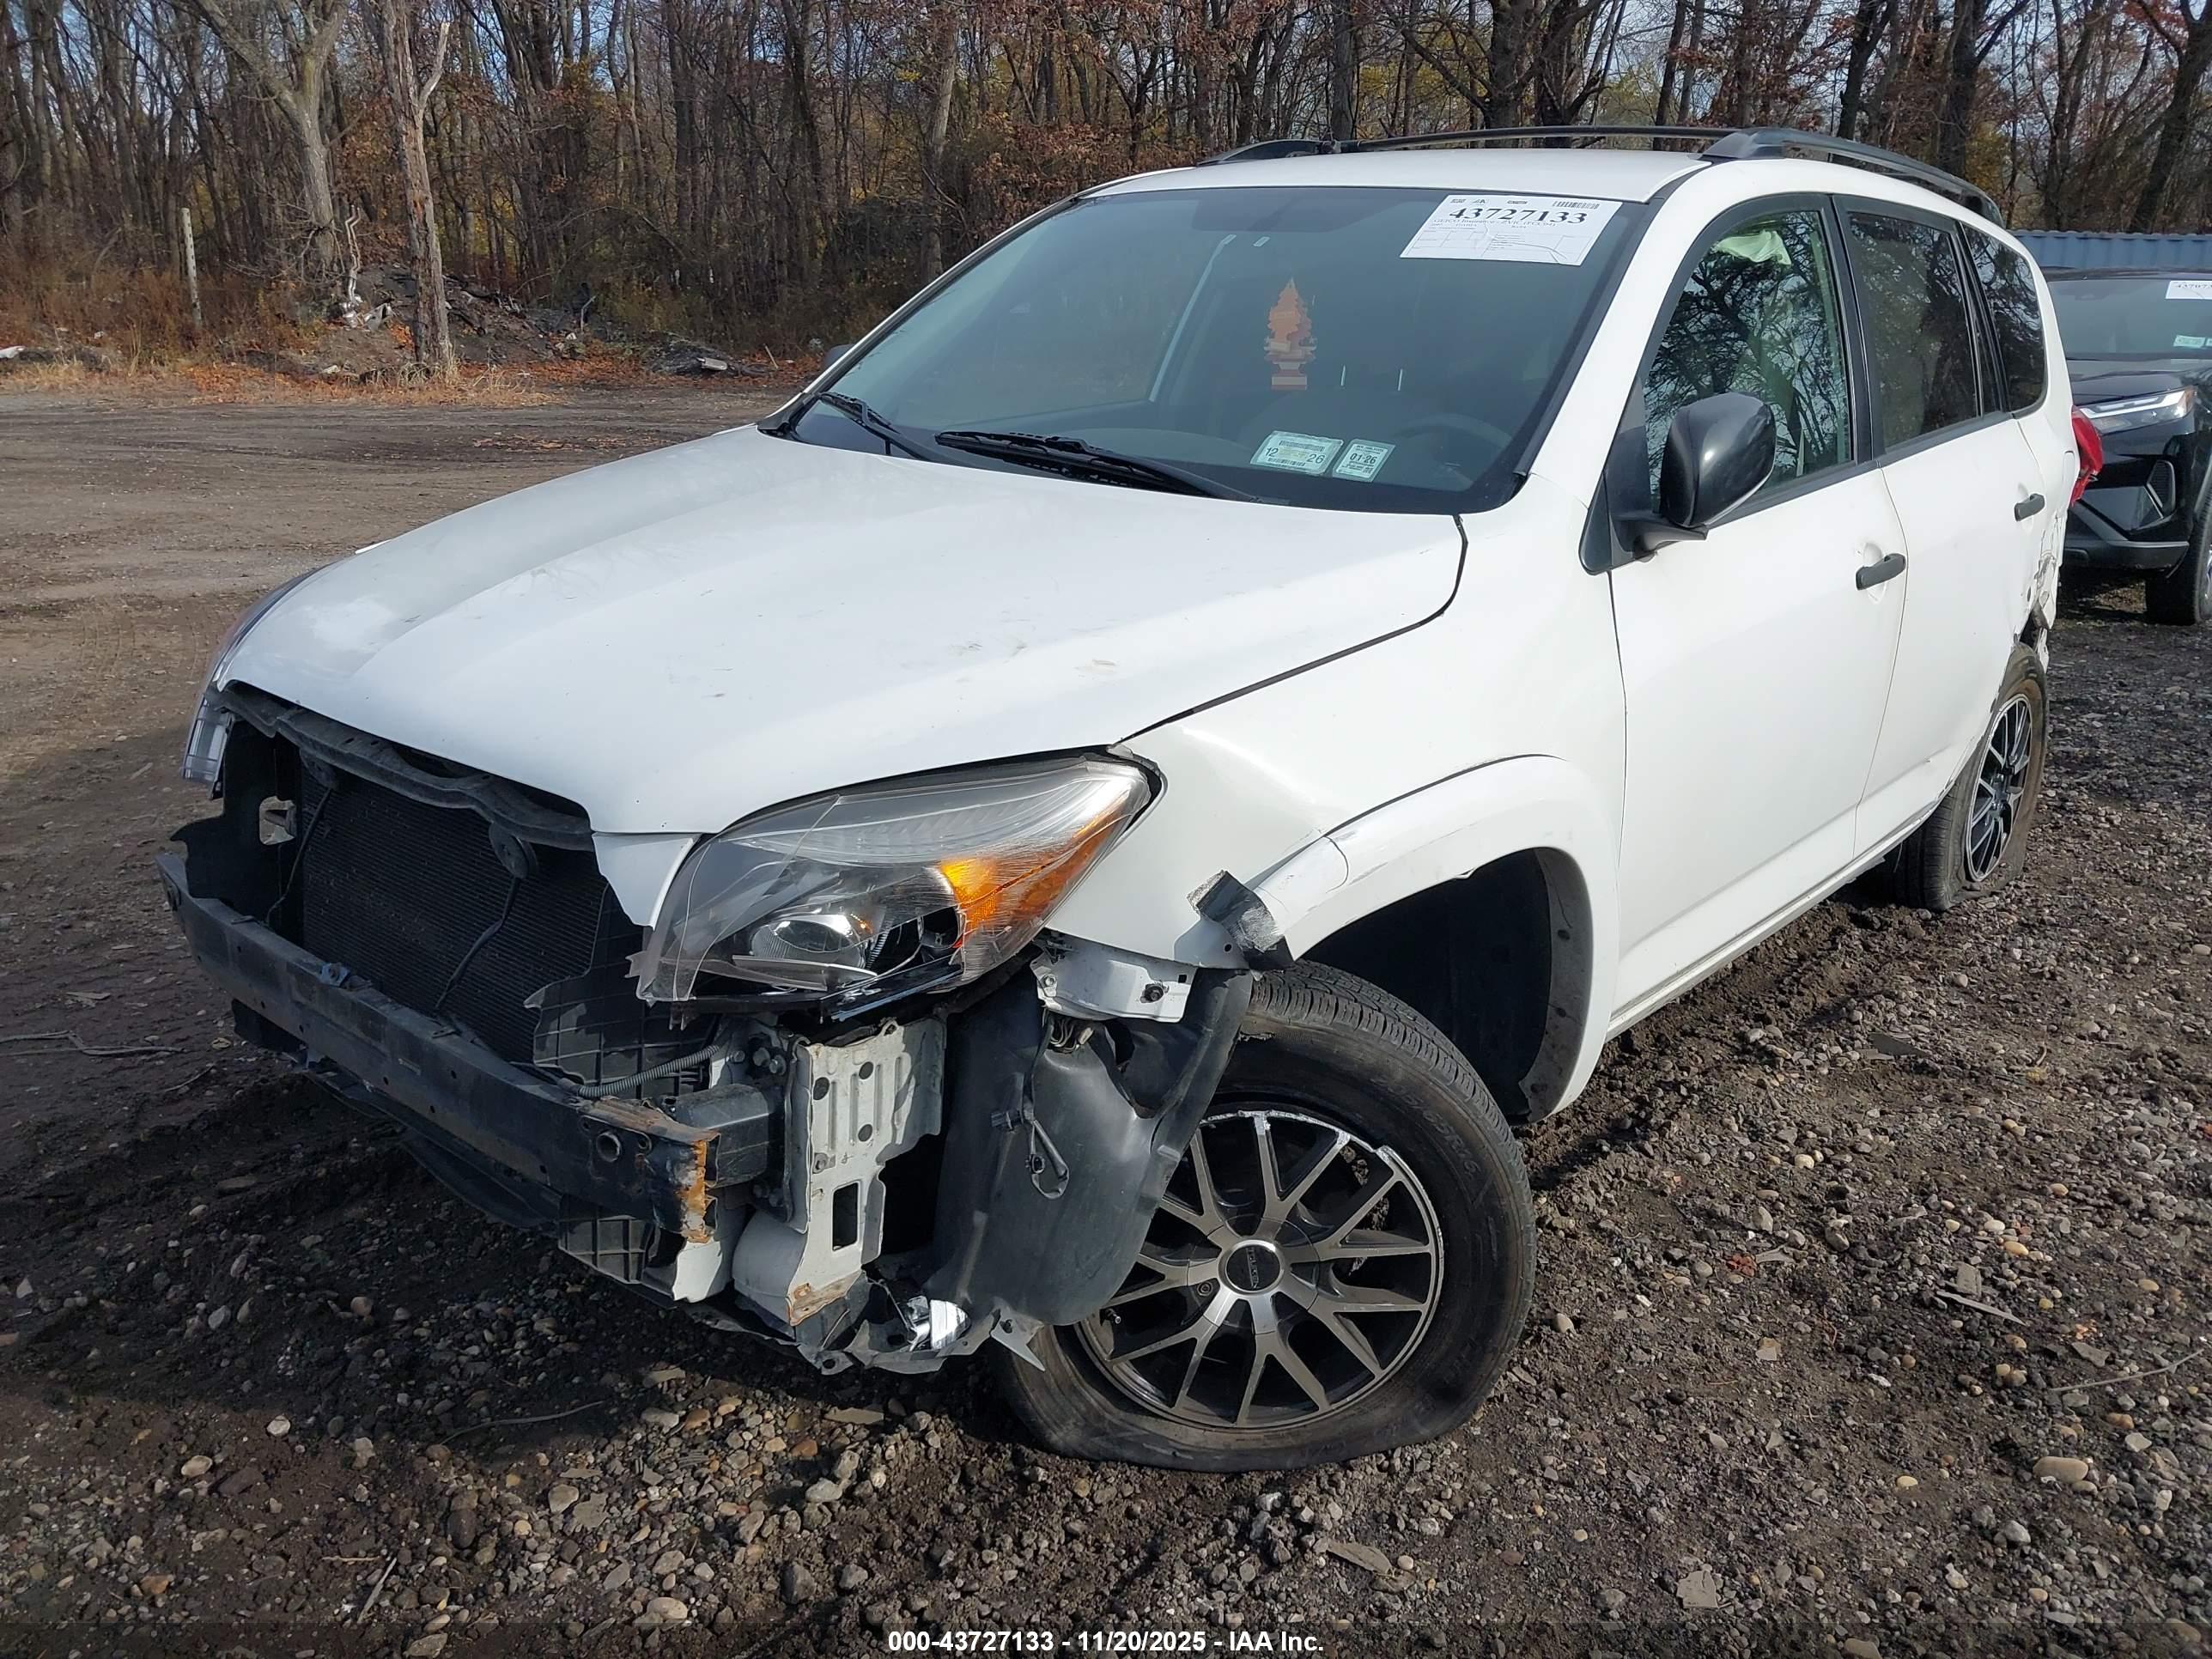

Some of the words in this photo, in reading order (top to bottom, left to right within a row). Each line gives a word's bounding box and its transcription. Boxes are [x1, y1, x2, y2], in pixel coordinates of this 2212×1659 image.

[1449, 208, 1588, 224] 43727133
[1266, 447, 1279, 457] 12
[1306, 453, 1326, 464] 26
